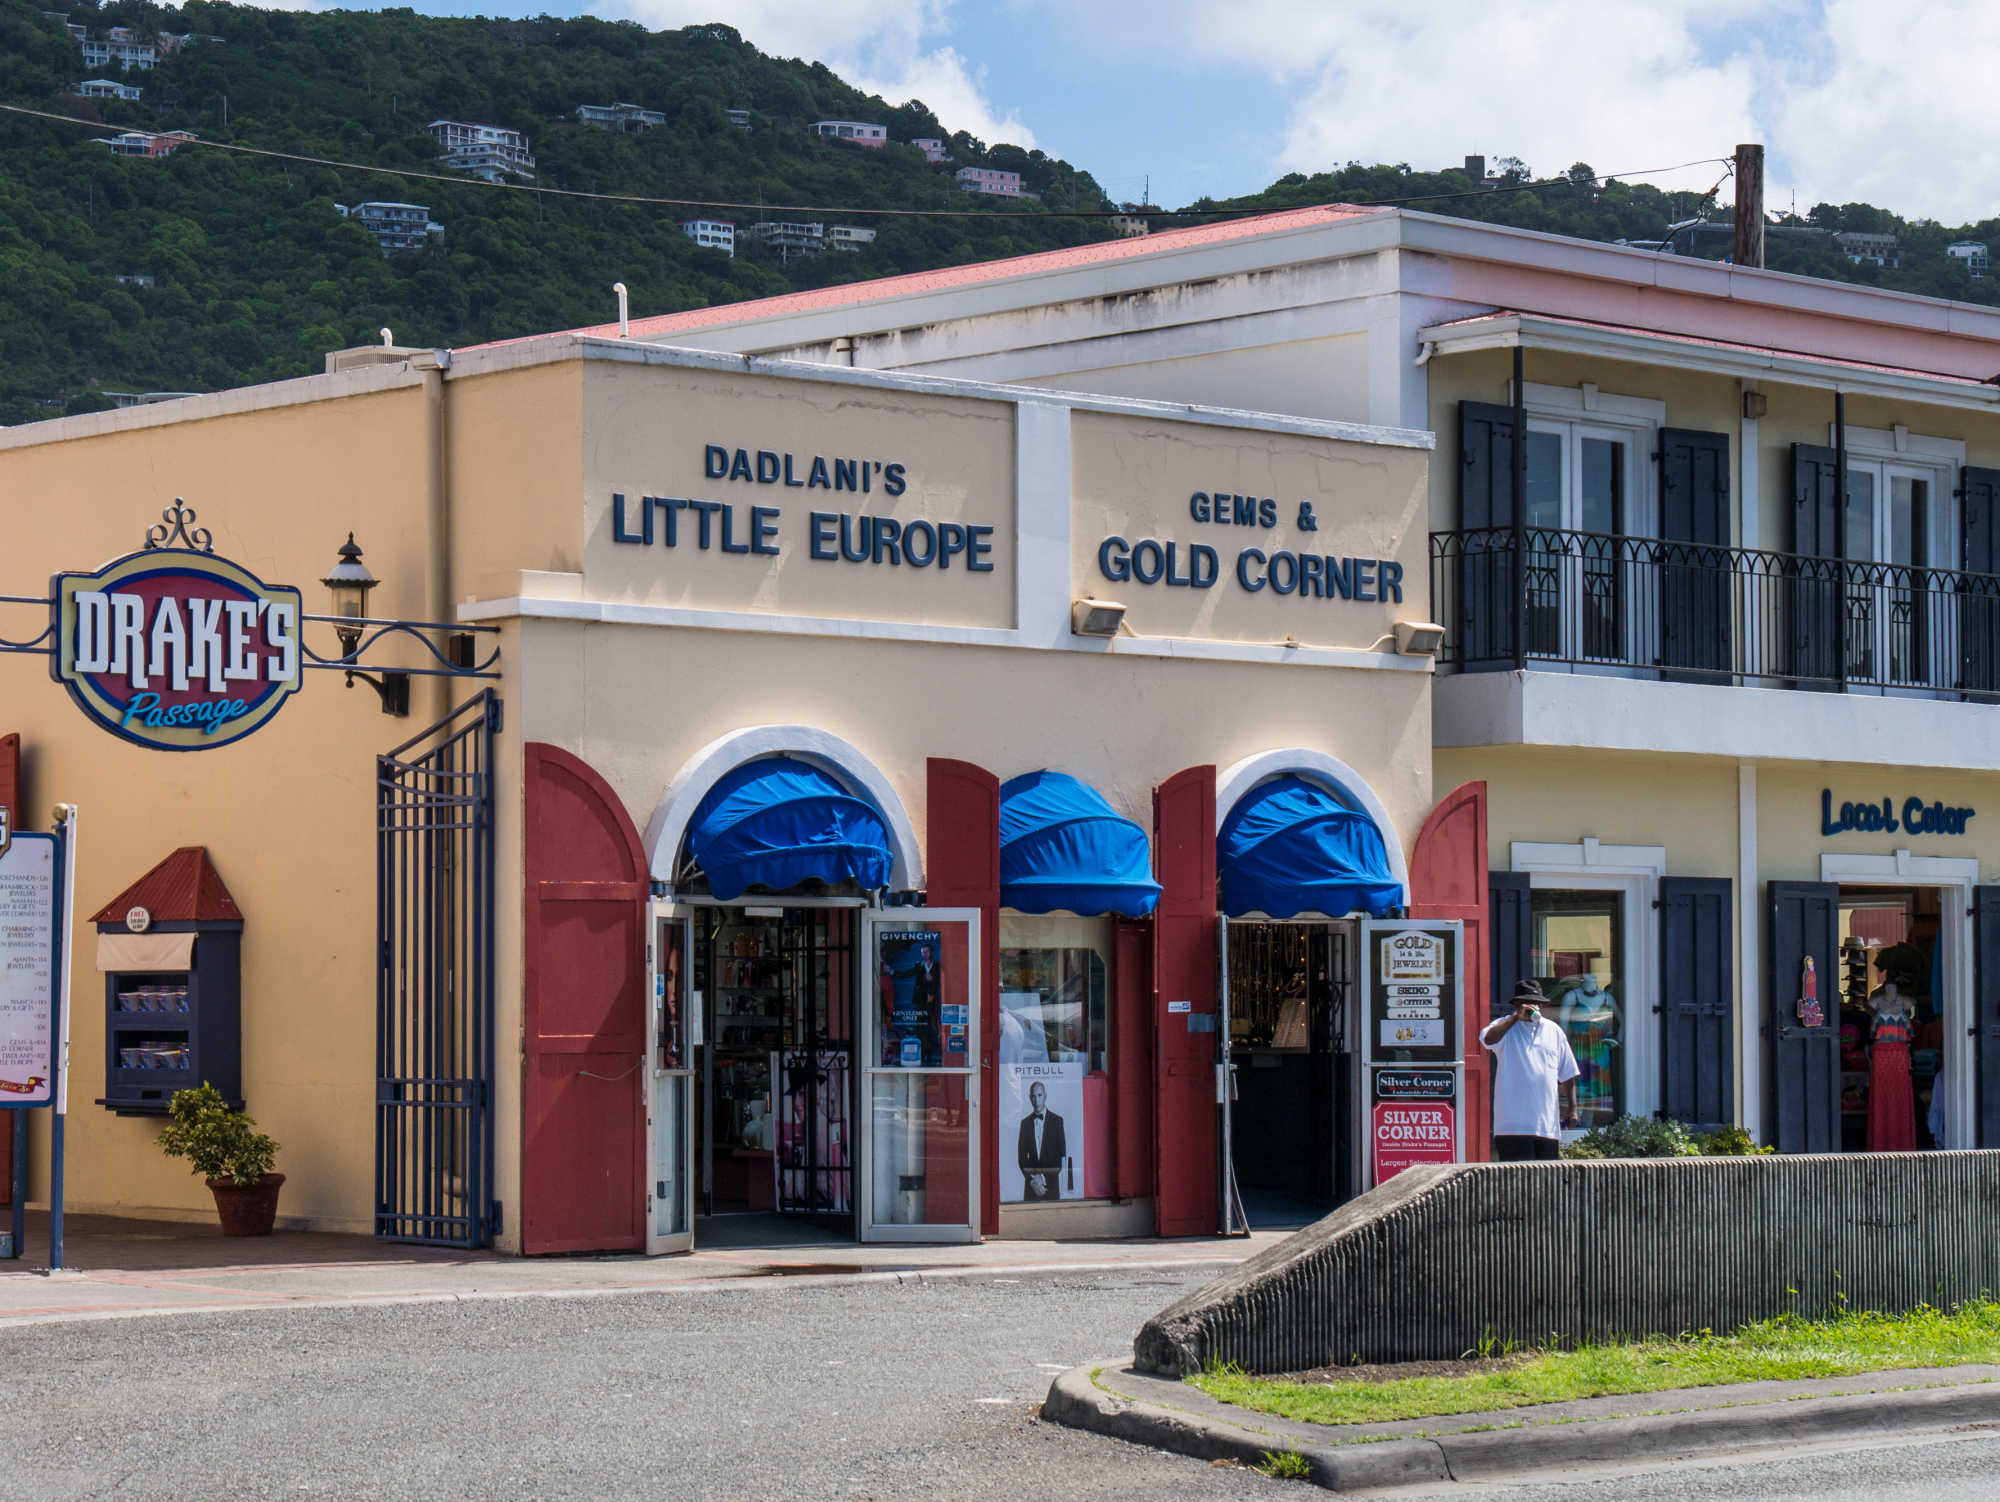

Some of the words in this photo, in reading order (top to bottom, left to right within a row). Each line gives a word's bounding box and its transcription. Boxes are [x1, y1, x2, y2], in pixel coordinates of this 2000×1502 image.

[705, 443, 907, 497] DADLANI'S
[1190, 490, 1277, 529] GEMS
[1296, 500, 1318, 531] &
[613, 492, 780, 556] LITTLE
[810, 510, 994, 572] EUROPE
[1098, 535, 1220, 589] GOLD
[1236, 547, 1404, 604] CORNER
[74, 590, 295, 693] DRAKE'S
[120, 691, 249, 735] Passage
[1821, 788, 1900, 836] Local
[1902, 796, 1976, 836] Color
[881, 932, 939, 941] GIVENCHY
[1394, 936, 1433, 949] GOLD
[1392, 960, 1433, 970] JEWELRY
[1397, 986, 1430, 995] SEIKO
[1403, 998, 1433, 1006] CITIZEN
[1015, 1066, 1064, 1075] PITBULL
[1380, 1076, 1411, 1087] Silver
[1413, 1076, 1452, 1087] Corner
[1383, 1111, 1444, 1124] SILVER
[1377, 1126, 1450, 1140] CORNER
